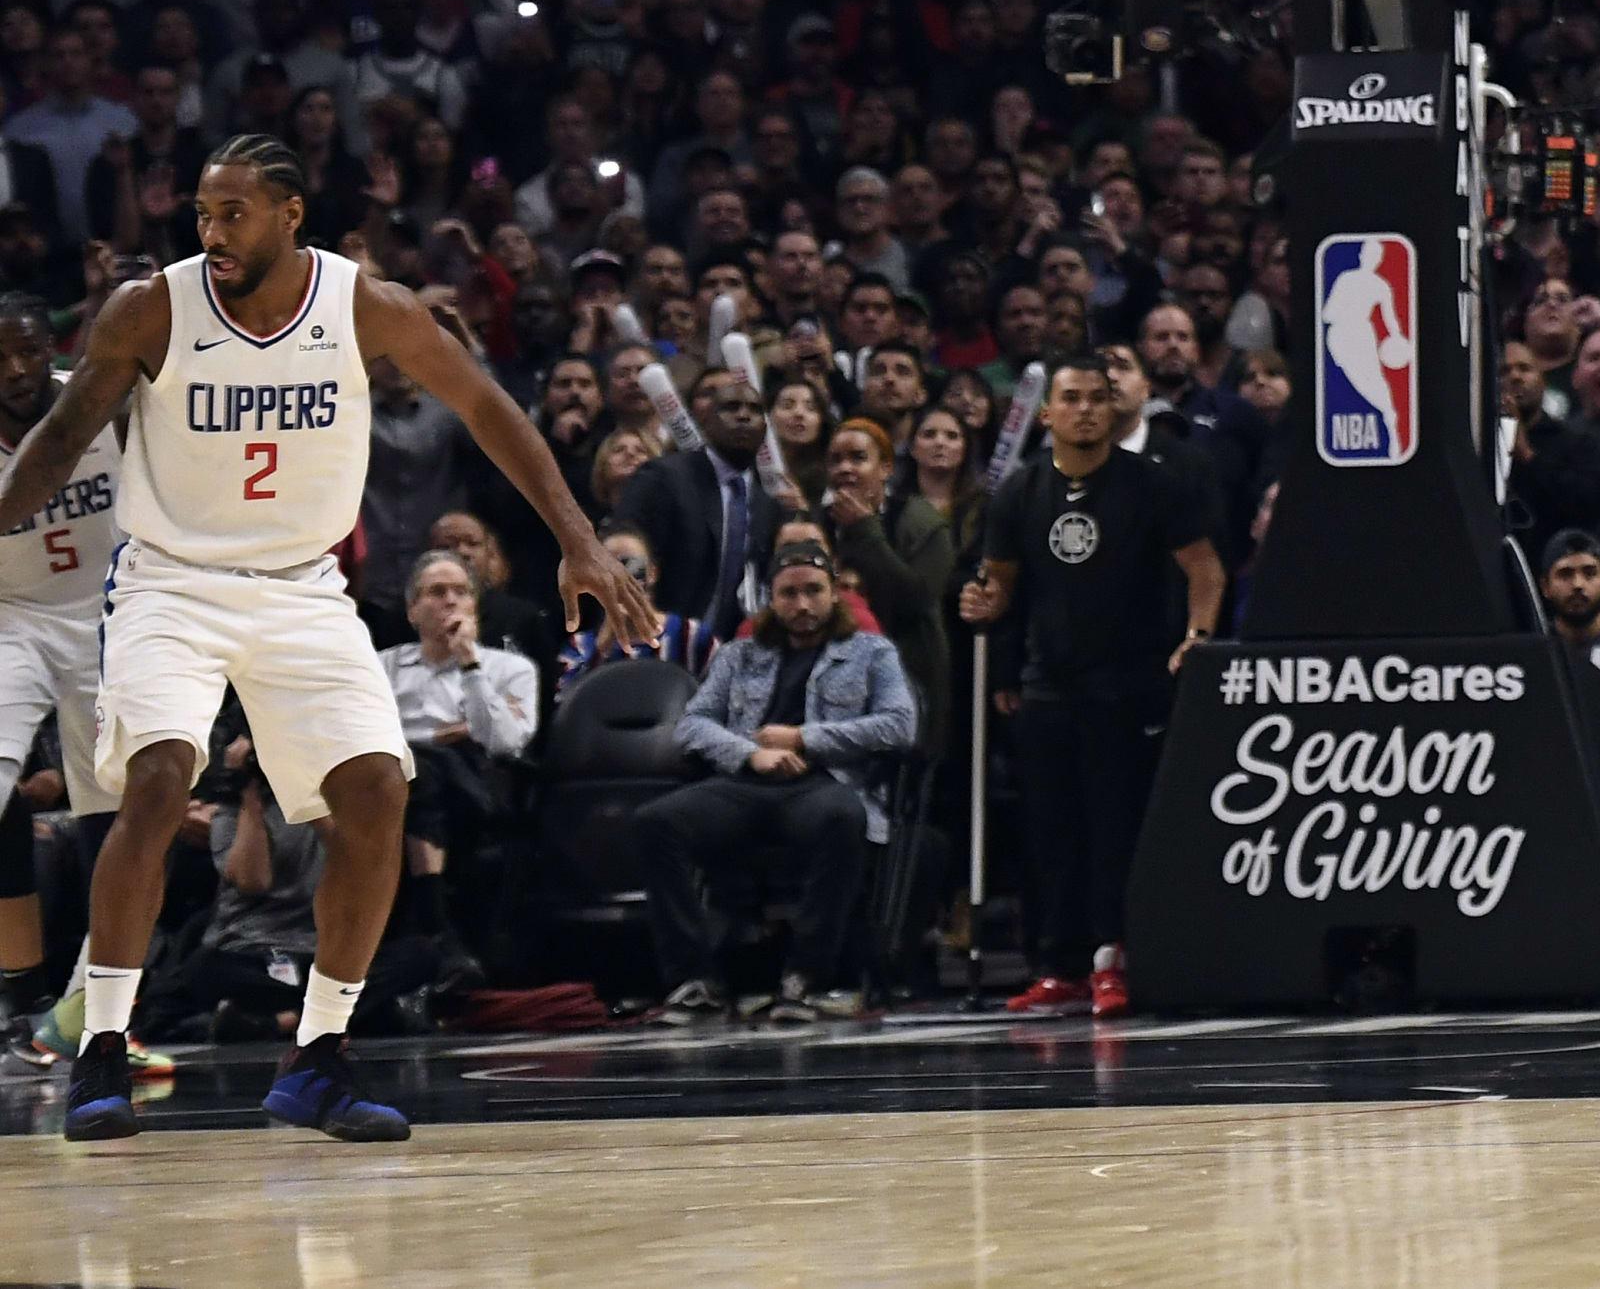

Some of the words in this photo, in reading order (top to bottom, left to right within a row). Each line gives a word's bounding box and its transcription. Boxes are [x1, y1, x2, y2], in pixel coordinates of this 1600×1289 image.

[1296, 93, 1437, 129] SPALDING
[299, 341, 339, 352] bumble
[186, 380, 339, 433] CLIPPERS
[1331, 413, 1380, 451] NBA
[243, 442, 278, 501] 2
[43, 528, 80, 574] 5
[1220, 655, 1527, 705] #NBACares
[1210, 714, 1497, 826] Season
[1222, 827, 1280, 897] of
[1284, 800, 1528, 918] Giving
